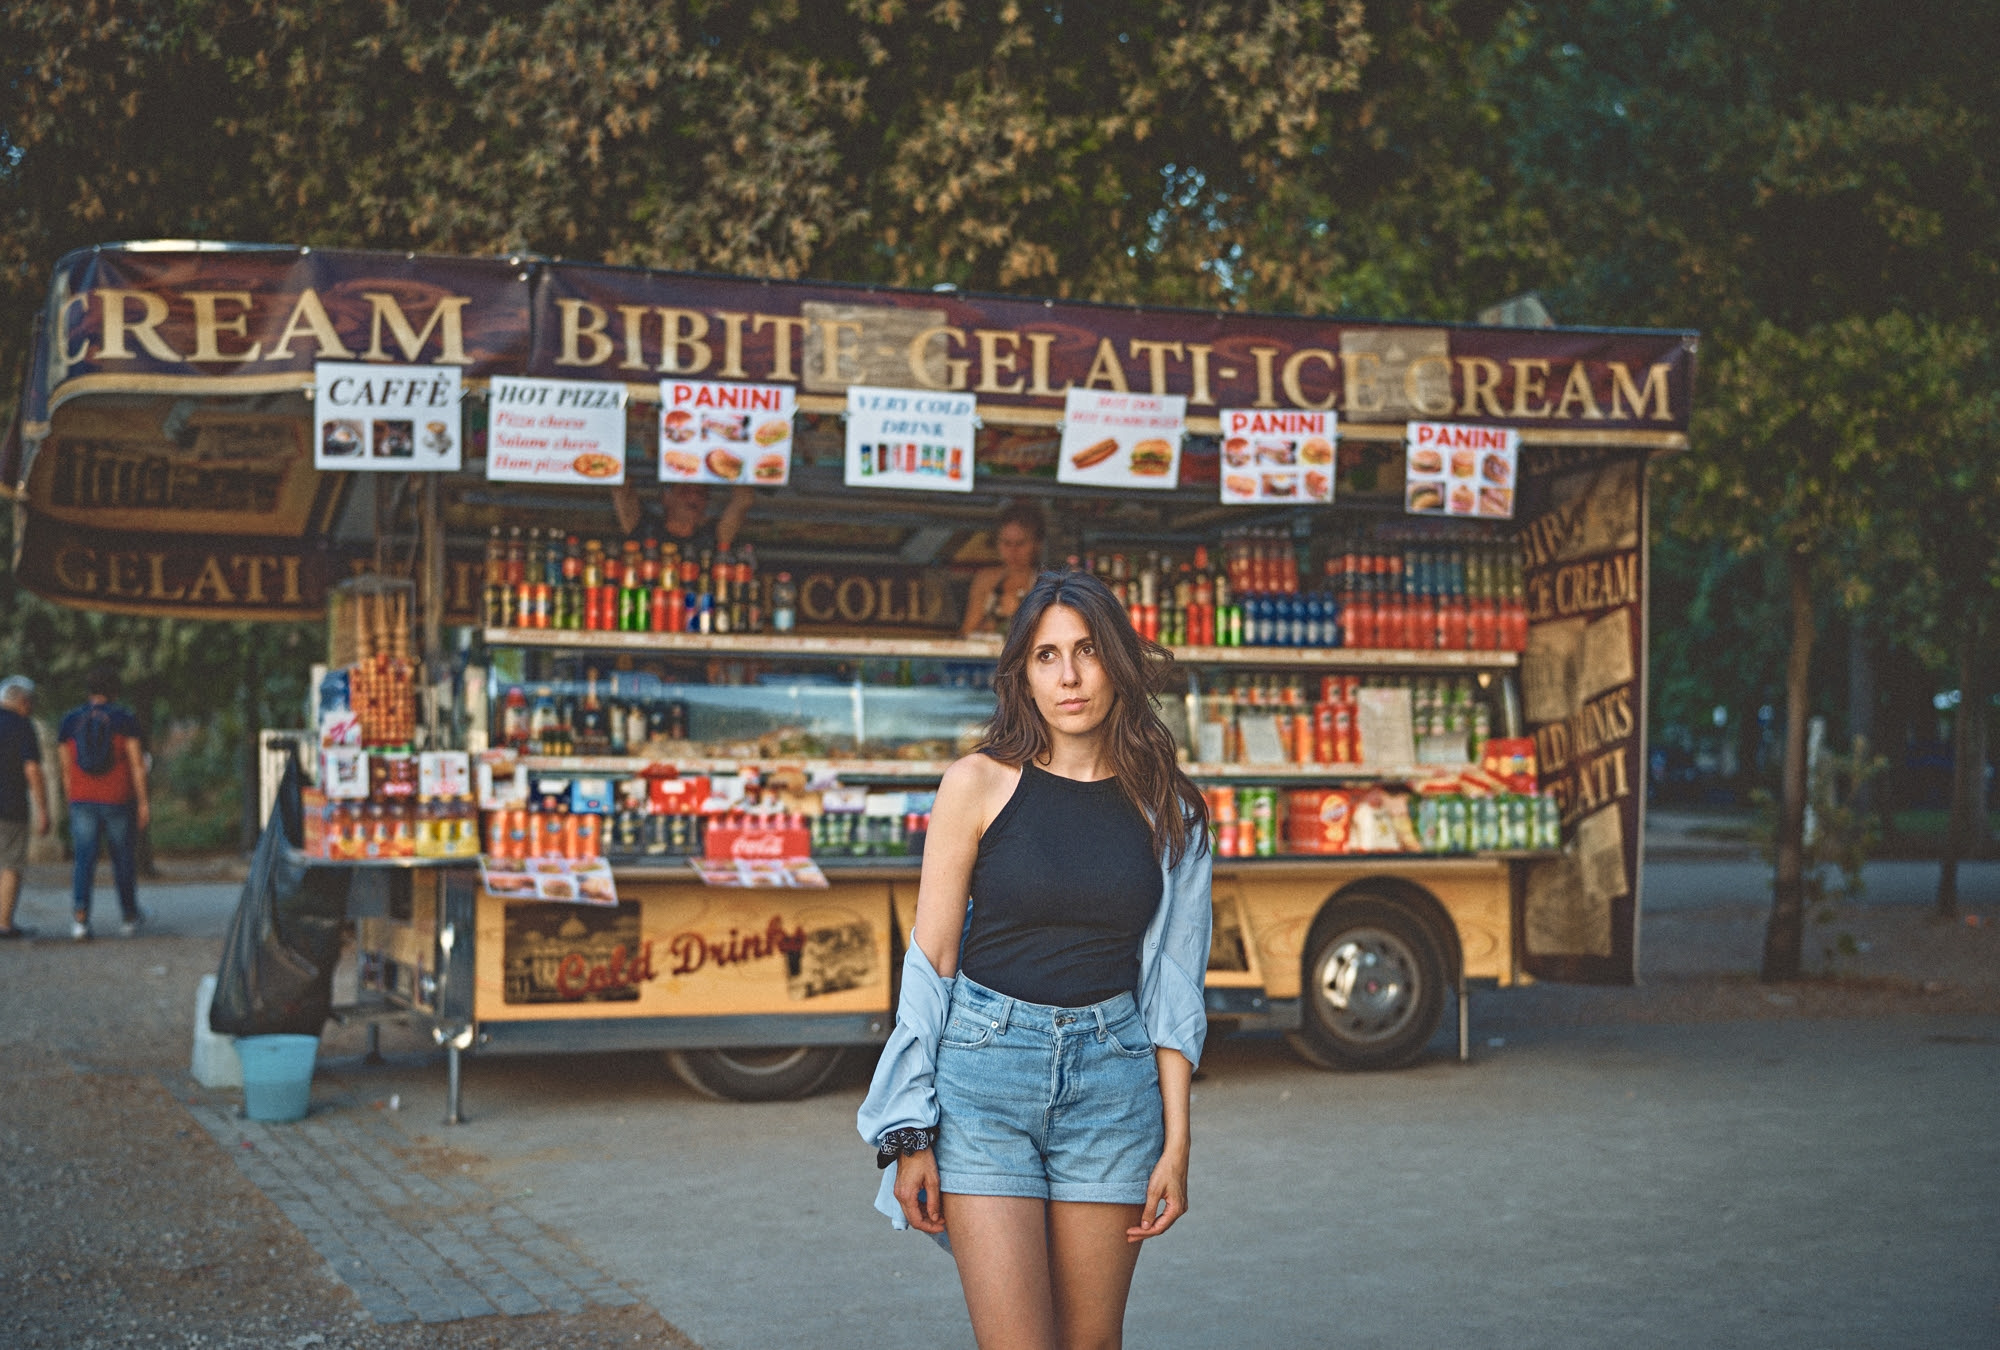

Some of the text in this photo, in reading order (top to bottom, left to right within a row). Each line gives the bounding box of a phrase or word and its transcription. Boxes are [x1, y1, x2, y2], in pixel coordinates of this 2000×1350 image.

[55, 285, 475, 365] CREAM
[328, 370, 453, 409] CAFFÈ
[499, 384, 620, 410] HOT PIZZA
[673, 384, 783, 412] PANINI
[858, 394, 972, 416] VERY COLD
[1404, 355, 1675, 422] CREAM
[880, 419, 945, 438] DRINK
[1231, 410, 1326, 435] PANINI
[1417, 423, 1507, 451] PANINI
[53, 544, 302, 603] GELATI
[1555, 551, 1638, 616] CREAM
[555, 937, 658, 1000] Cold
